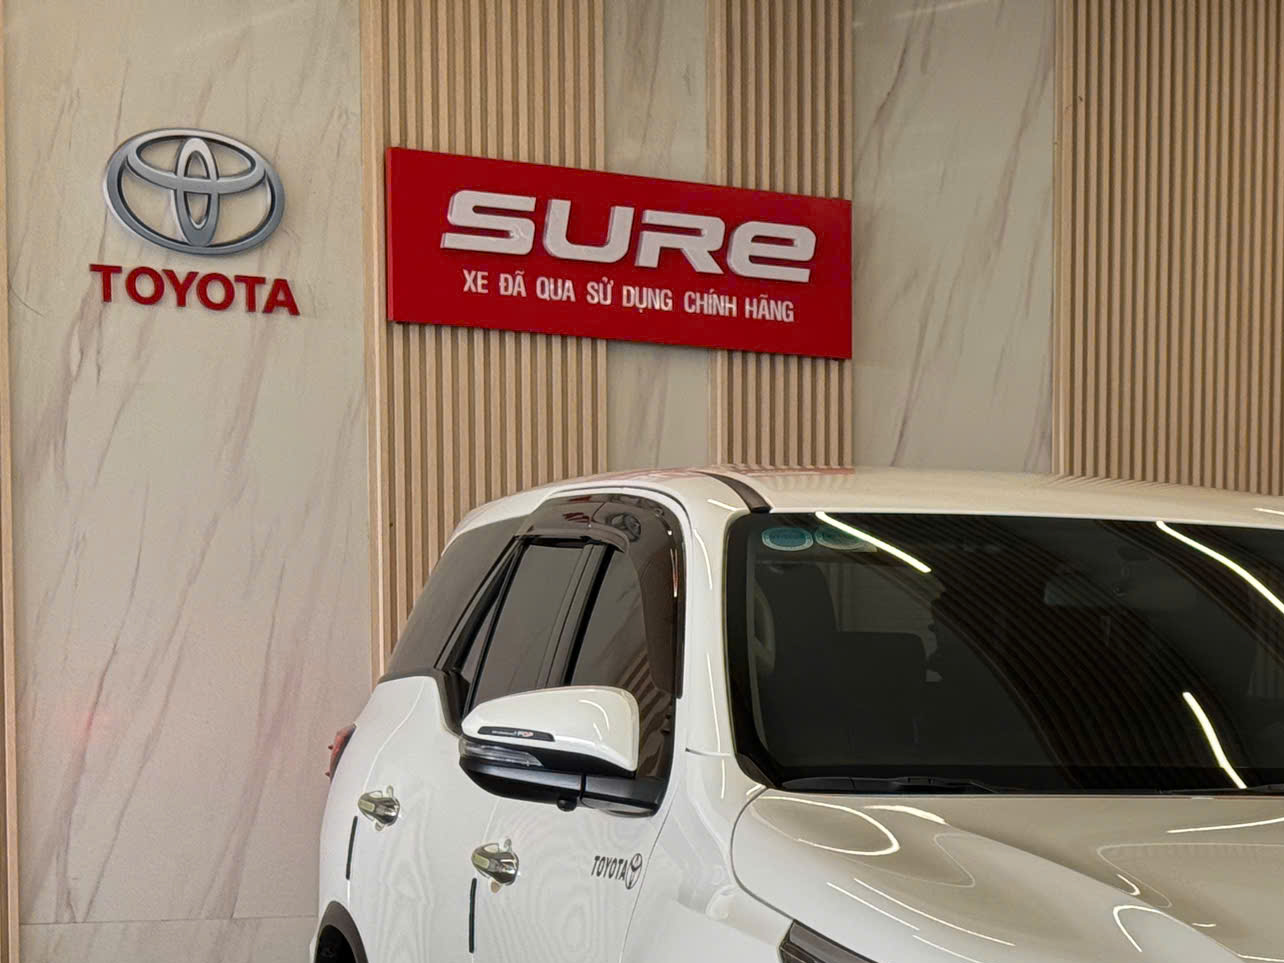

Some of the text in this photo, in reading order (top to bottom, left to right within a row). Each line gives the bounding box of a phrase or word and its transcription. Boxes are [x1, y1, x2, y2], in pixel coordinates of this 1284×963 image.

[89, 263, 300, 316] TOYOTA
[463, 269, 795, 322] XE ĐÃ QUA SỬ DỤNG CHÍNH HÃNG
[591, 855, 628, 880] TOYOTA
